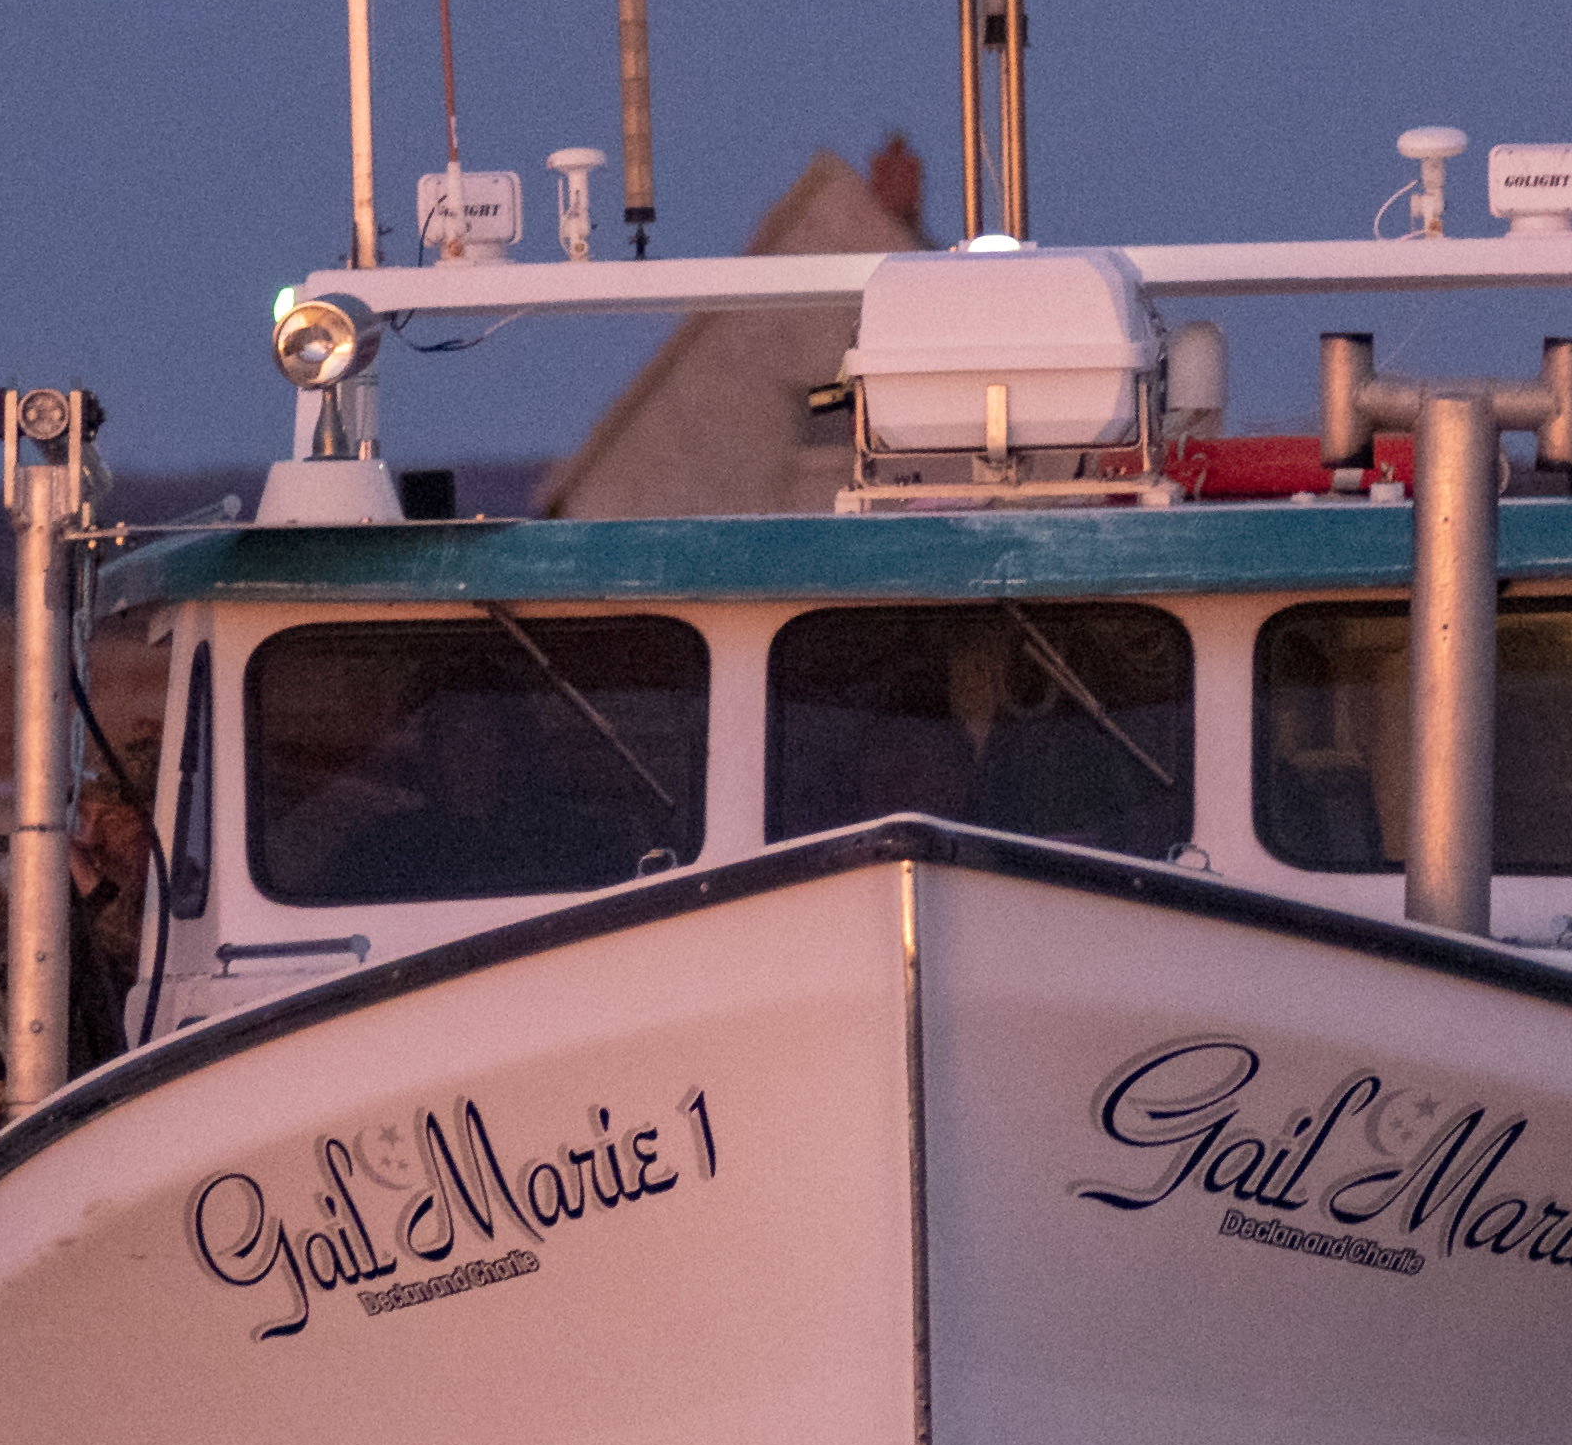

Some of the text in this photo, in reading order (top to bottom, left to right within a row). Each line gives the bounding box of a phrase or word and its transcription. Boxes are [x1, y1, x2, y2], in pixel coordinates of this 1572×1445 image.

[1074, 1039, 1381, 1211] Gail
[191, 1089, 718, 1341] Gail Marie 1
[1219, 1208, 1426, 1277] Declan and Charlie
[357, 1249, 541, 1317] Declan and Charlie
